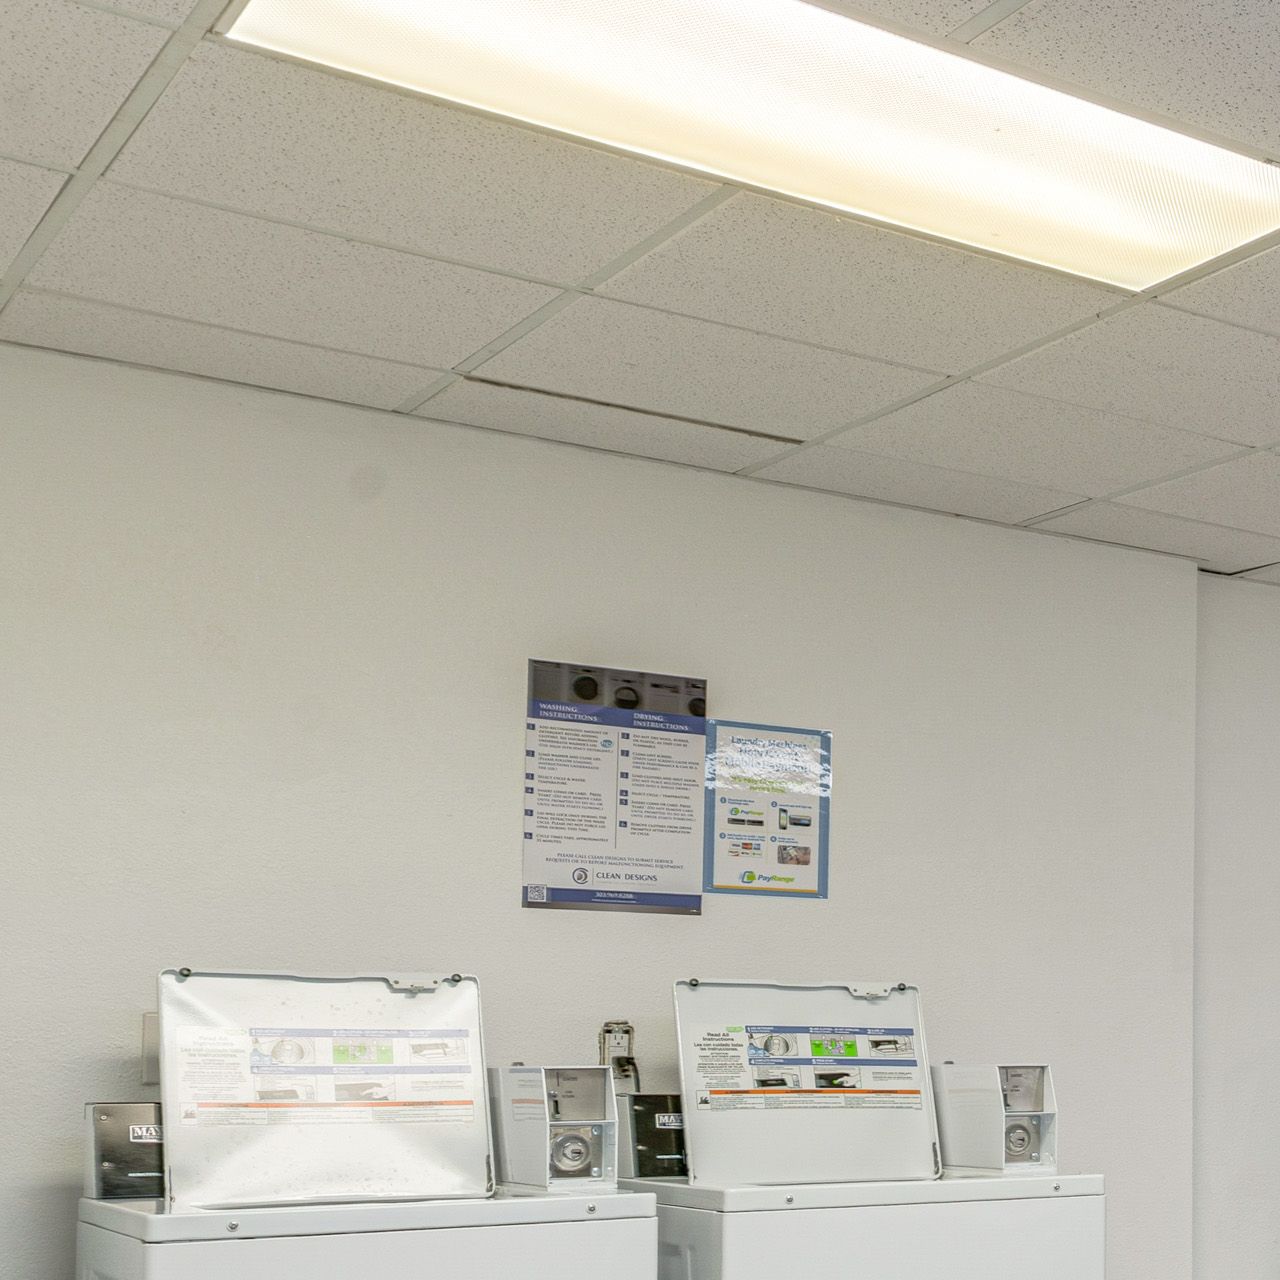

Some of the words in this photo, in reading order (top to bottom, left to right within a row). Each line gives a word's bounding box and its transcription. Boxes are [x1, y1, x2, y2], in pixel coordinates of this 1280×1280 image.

[540, 703, 577, 712] WASHING
[540, 710, 598, 721] INSTRUCTIONS
[633, 713, 664, 721] DRYING
[633, 720, 689, 730] INSTRUCTIONS
[624, 873, 658, 882] DESIGNS
[758, 874, 795, 883] PayRange
